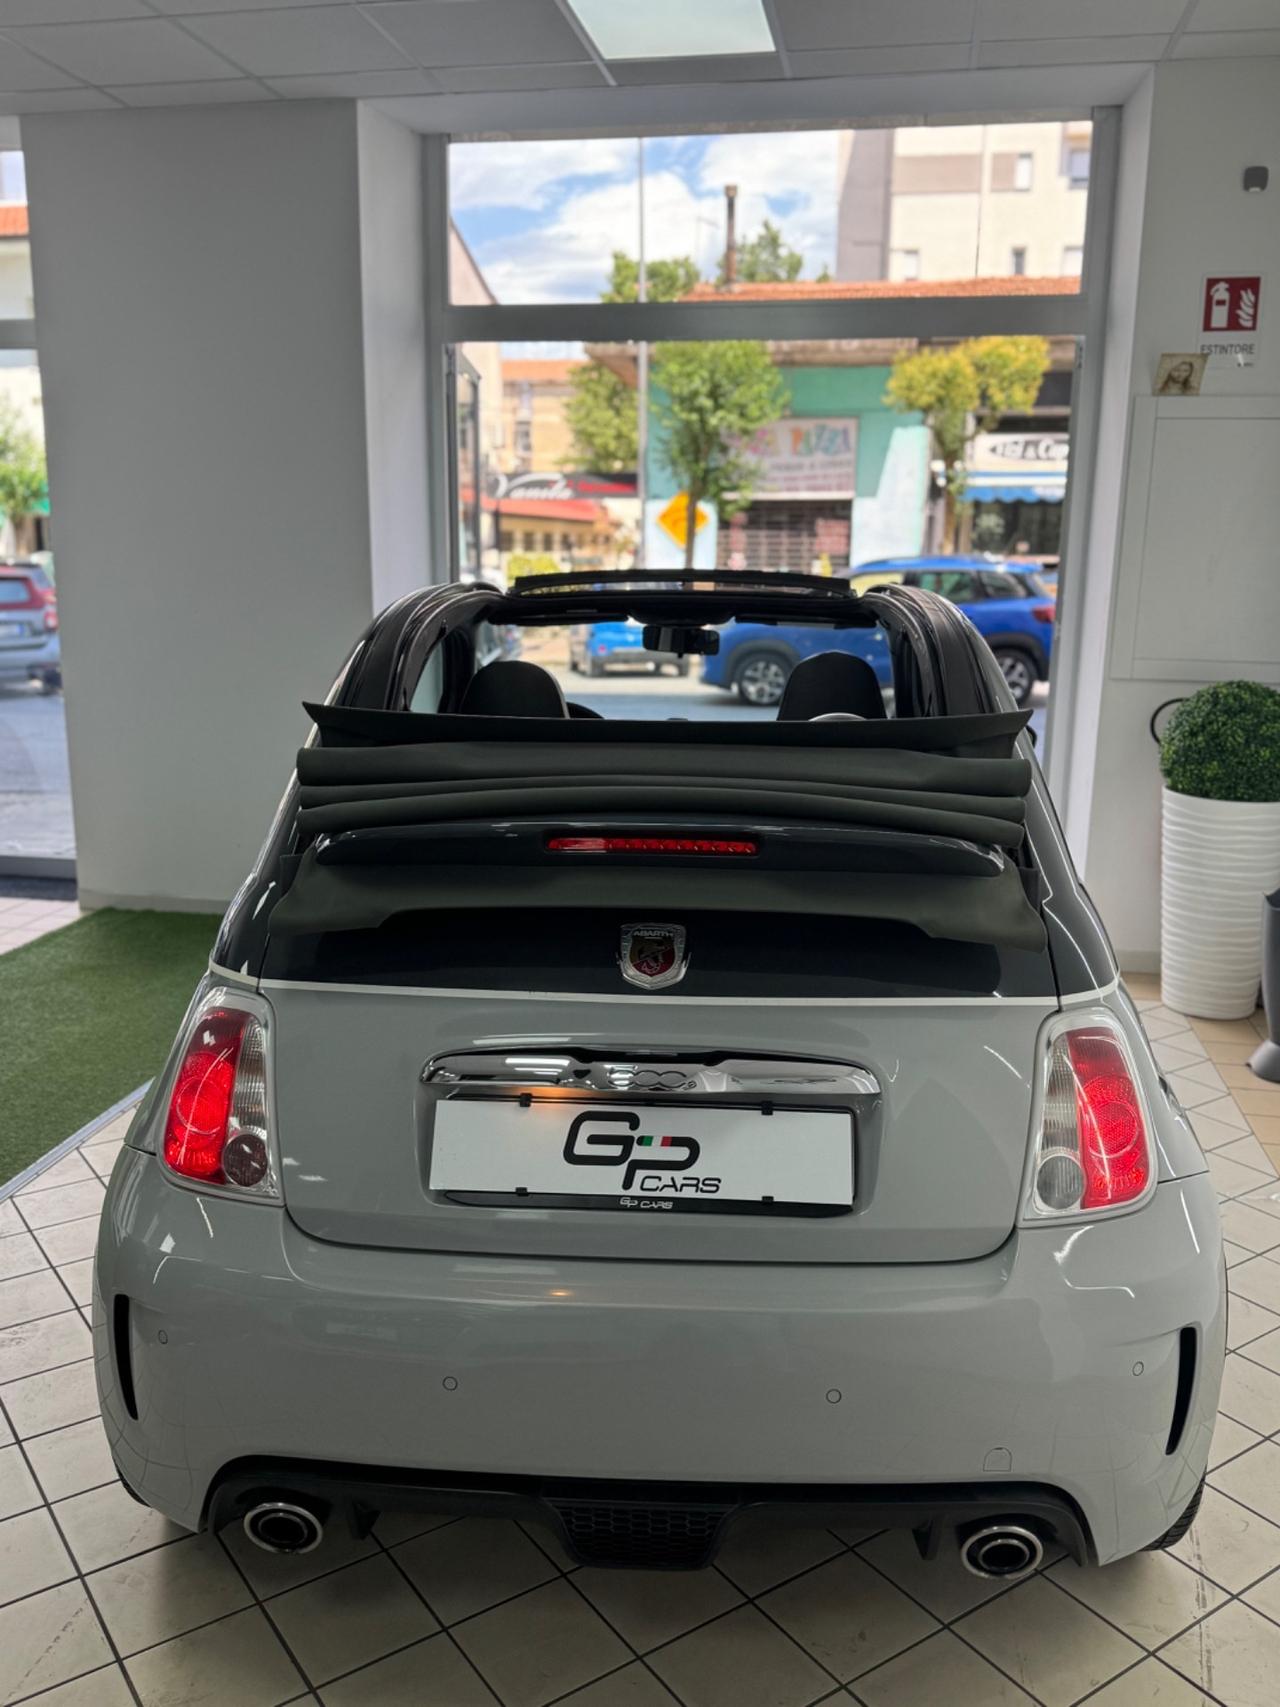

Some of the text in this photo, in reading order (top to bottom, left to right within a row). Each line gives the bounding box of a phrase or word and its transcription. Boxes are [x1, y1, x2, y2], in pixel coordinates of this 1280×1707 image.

[1200, 342, 1255, 355] ESTINTORE
[633, 929, 674, 938] ABARTH
[563, 1110, 722, 1194] GP CARS
[640, 1200, 674, 1210] CARS
